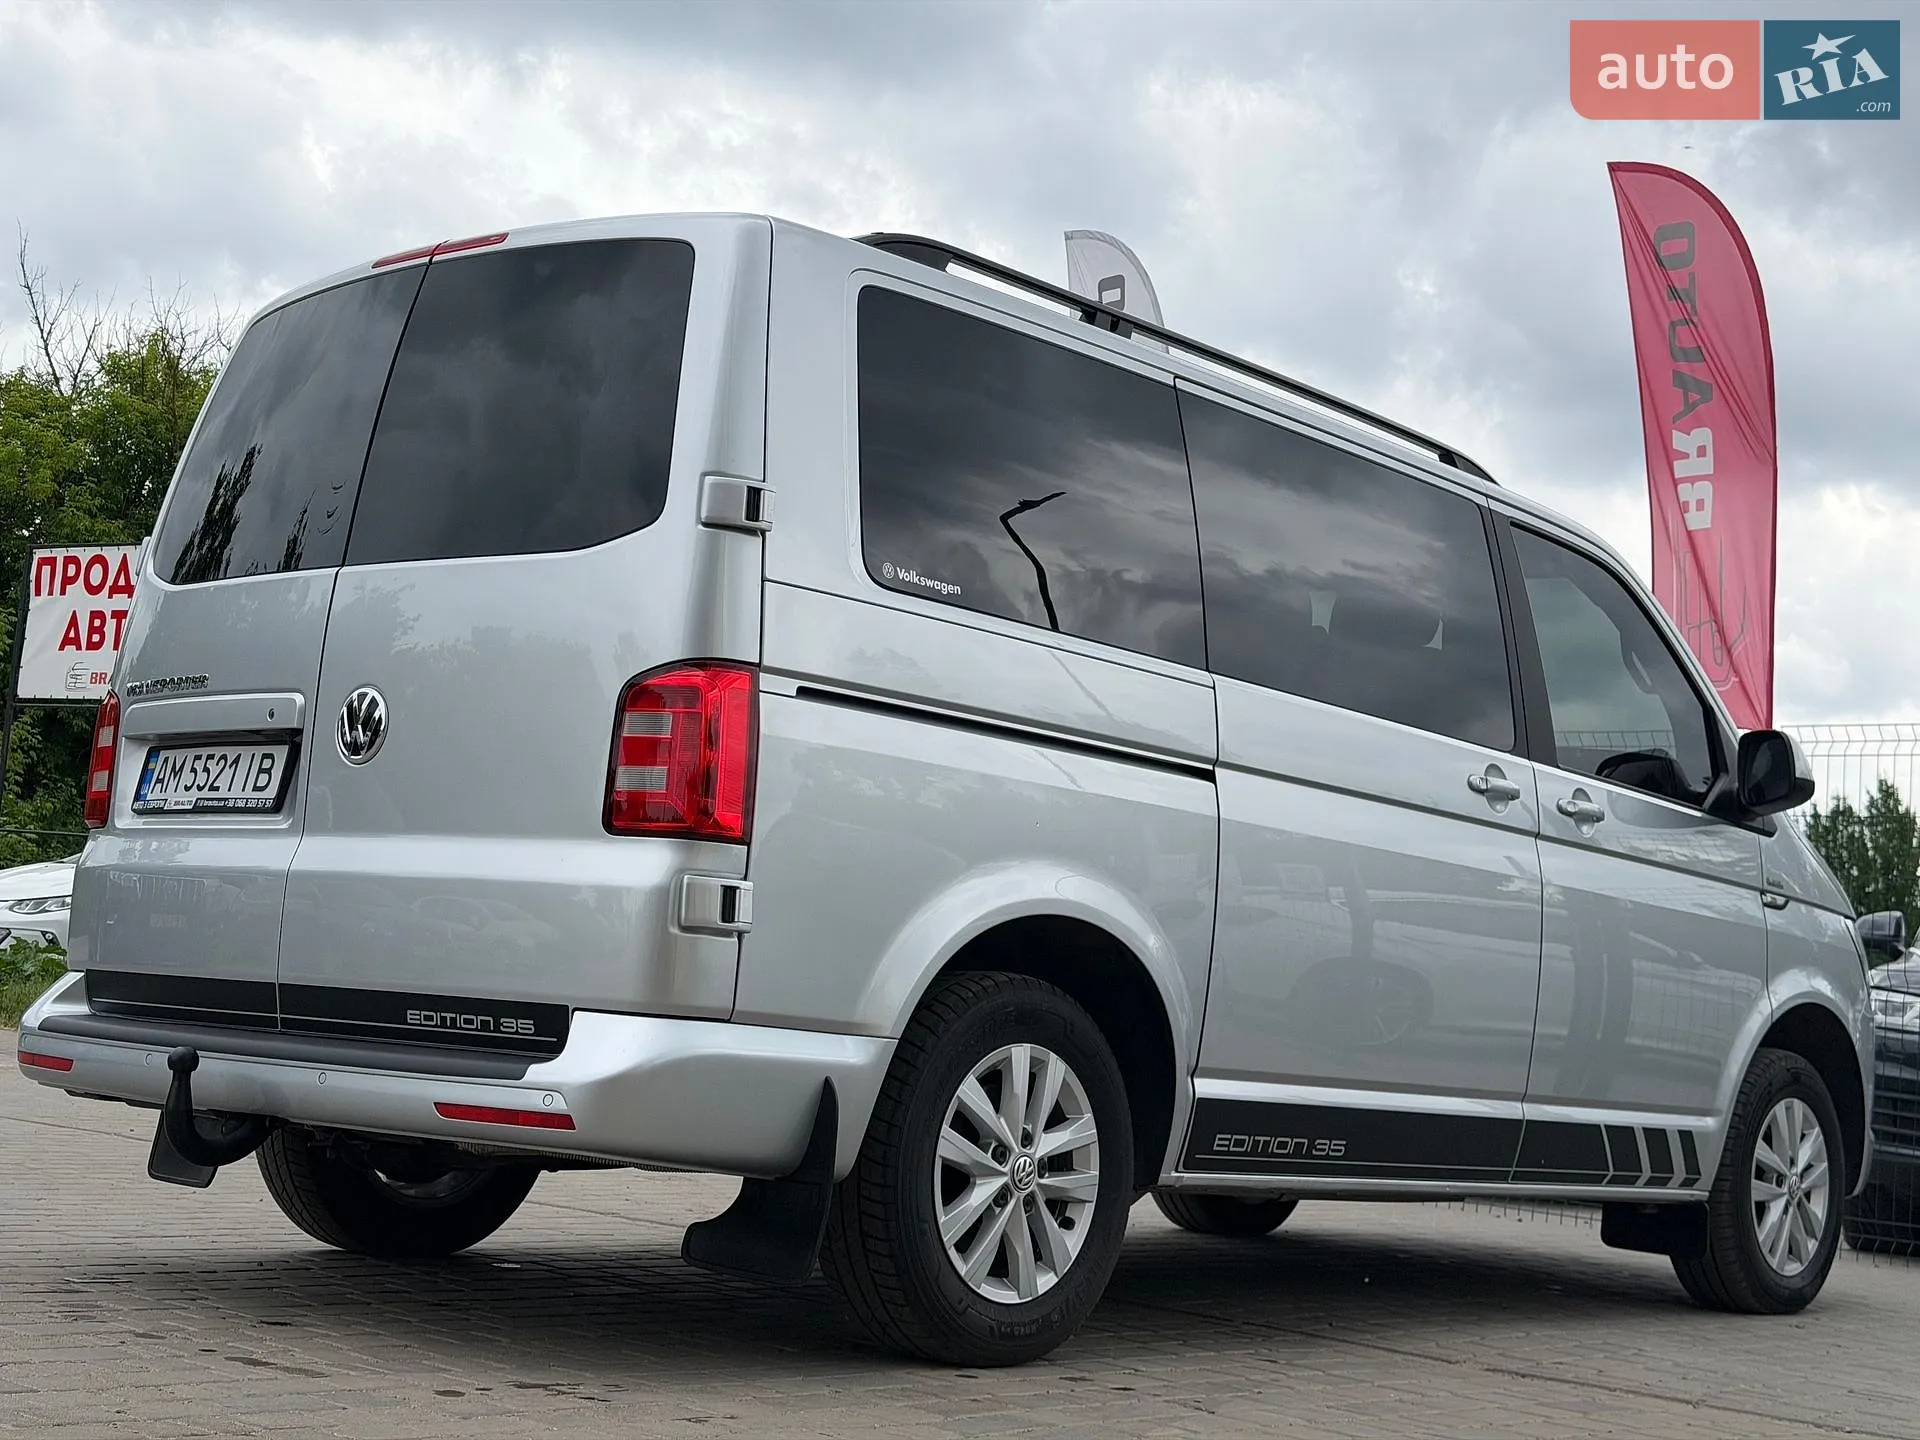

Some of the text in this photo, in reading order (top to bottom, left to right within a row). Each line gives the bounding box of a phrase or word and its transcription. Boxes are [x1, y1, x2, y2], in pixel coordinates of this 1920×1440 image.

[896, 566, 962, 595] Volkswagen
[406, 1009, 535, 1034] EDITION 35
[1213, 1134, 1347, 1156] EDITION 35
